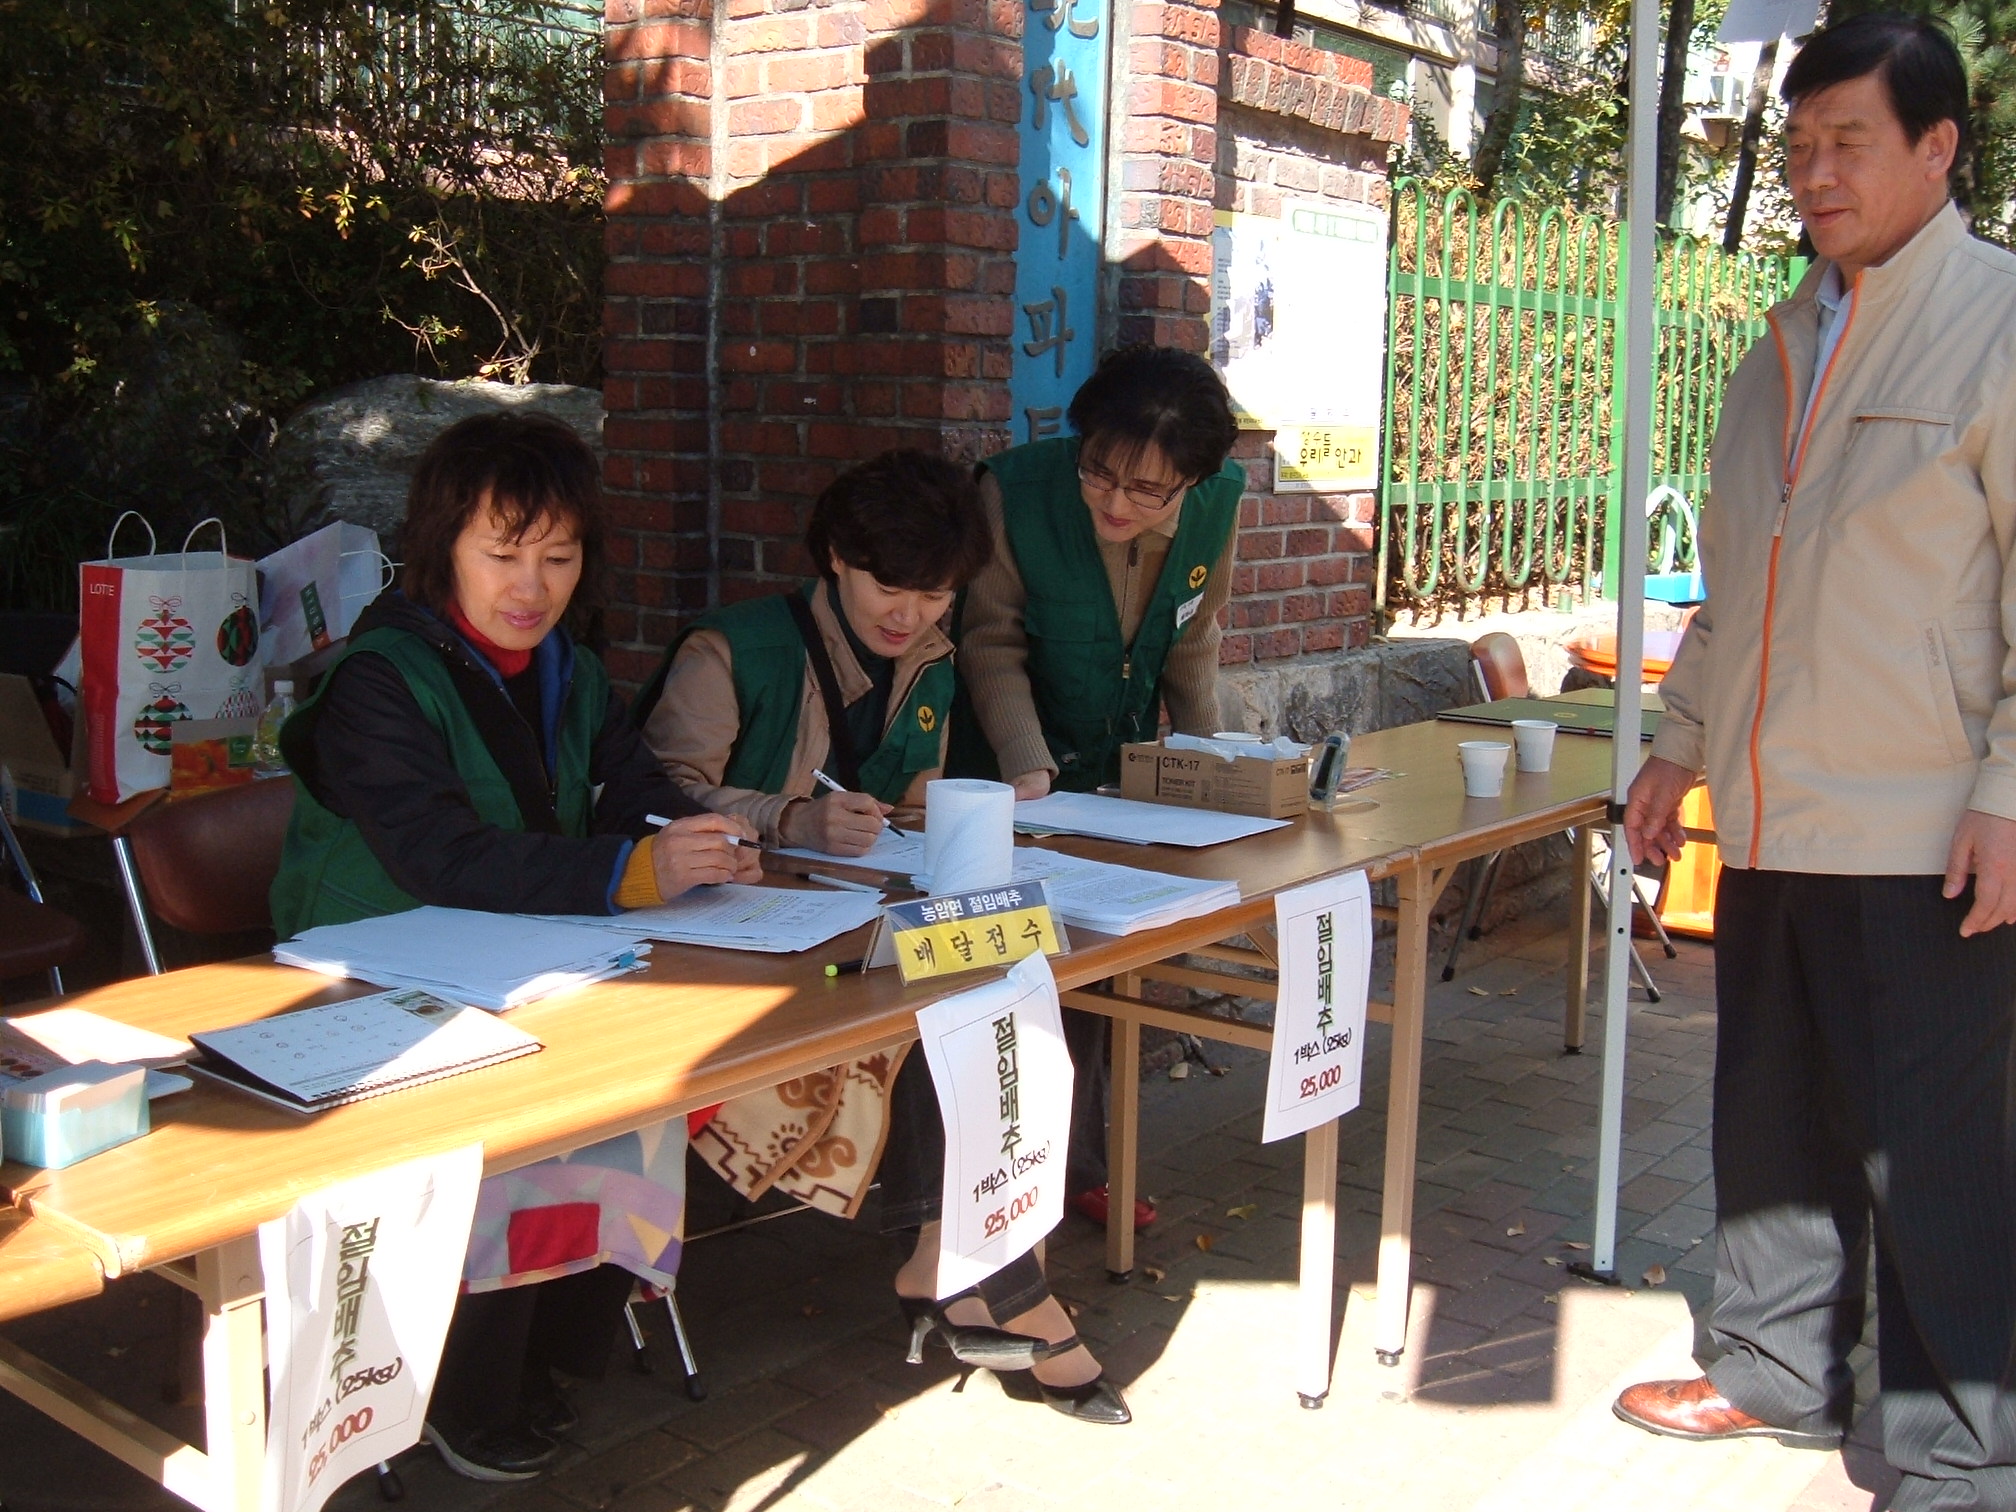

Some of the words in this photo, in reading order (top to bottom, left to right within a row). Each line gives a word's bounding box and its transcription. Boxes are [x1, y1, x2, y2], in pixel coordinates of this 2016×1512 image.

[90, 583, 114, 597] LOTTE
[1162, 756, 1200, 771] CTK-17
[921, 901, 964, 922] 농암면
[969, 889, 1022, 913] 절임배추
[1316, 912, 1334, 1036] 절임배추
[992, 1012, 1022, 1161] 절임배추
[1299, 1065, 1341, 1099] 25,000
[972, 1167, 1008, 1203] 1박스
[984, 1186, 1039, 1239] 25,000
[330, 1216, 380, 1383] 절임배추
[308, 1406, 373, 1487] 25,000
